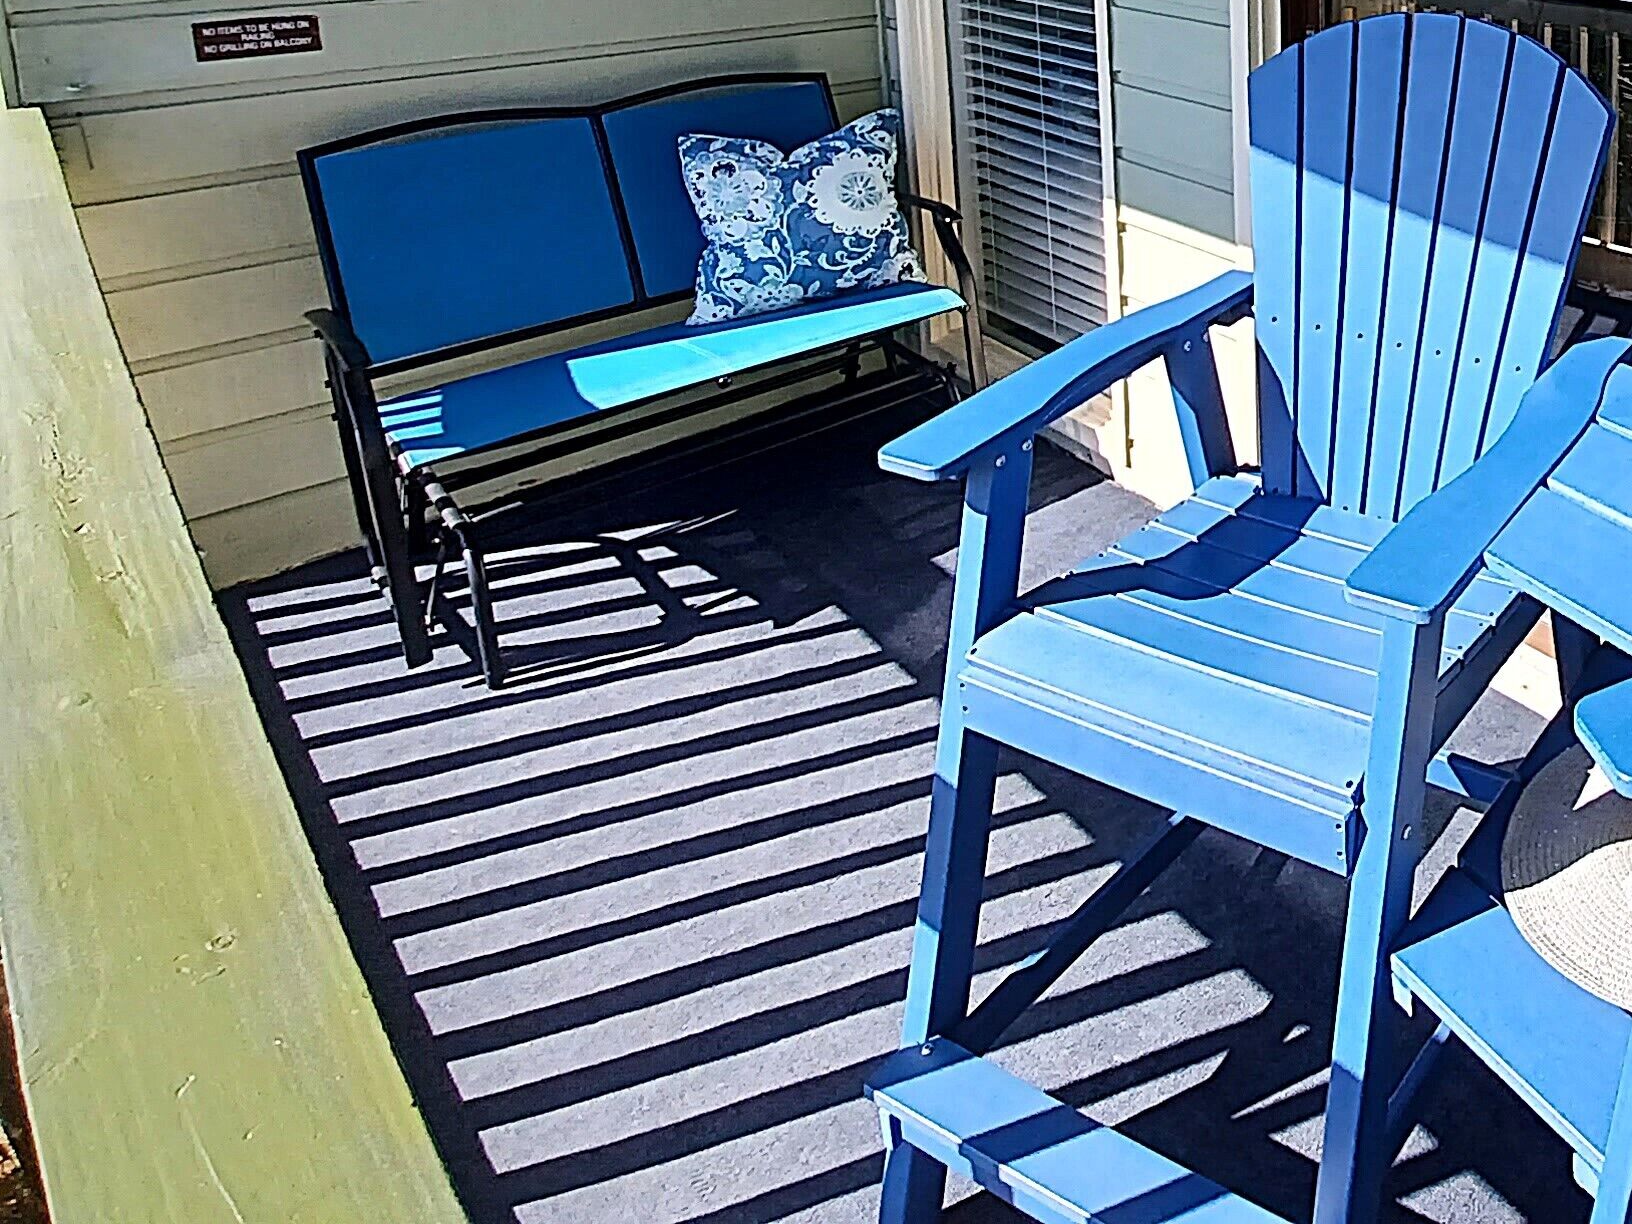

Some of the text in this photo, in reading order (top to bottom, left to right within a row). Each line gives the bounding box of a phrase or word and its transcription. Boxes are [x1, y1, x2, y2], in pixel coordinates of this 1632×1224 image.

[202, 20, 310, 36] NO ITEMS TO BE HUNG ON
[240, 32, 275, 41] RAILING
[204, 36, 313, 54] NO GRILLING ON BALCONY
